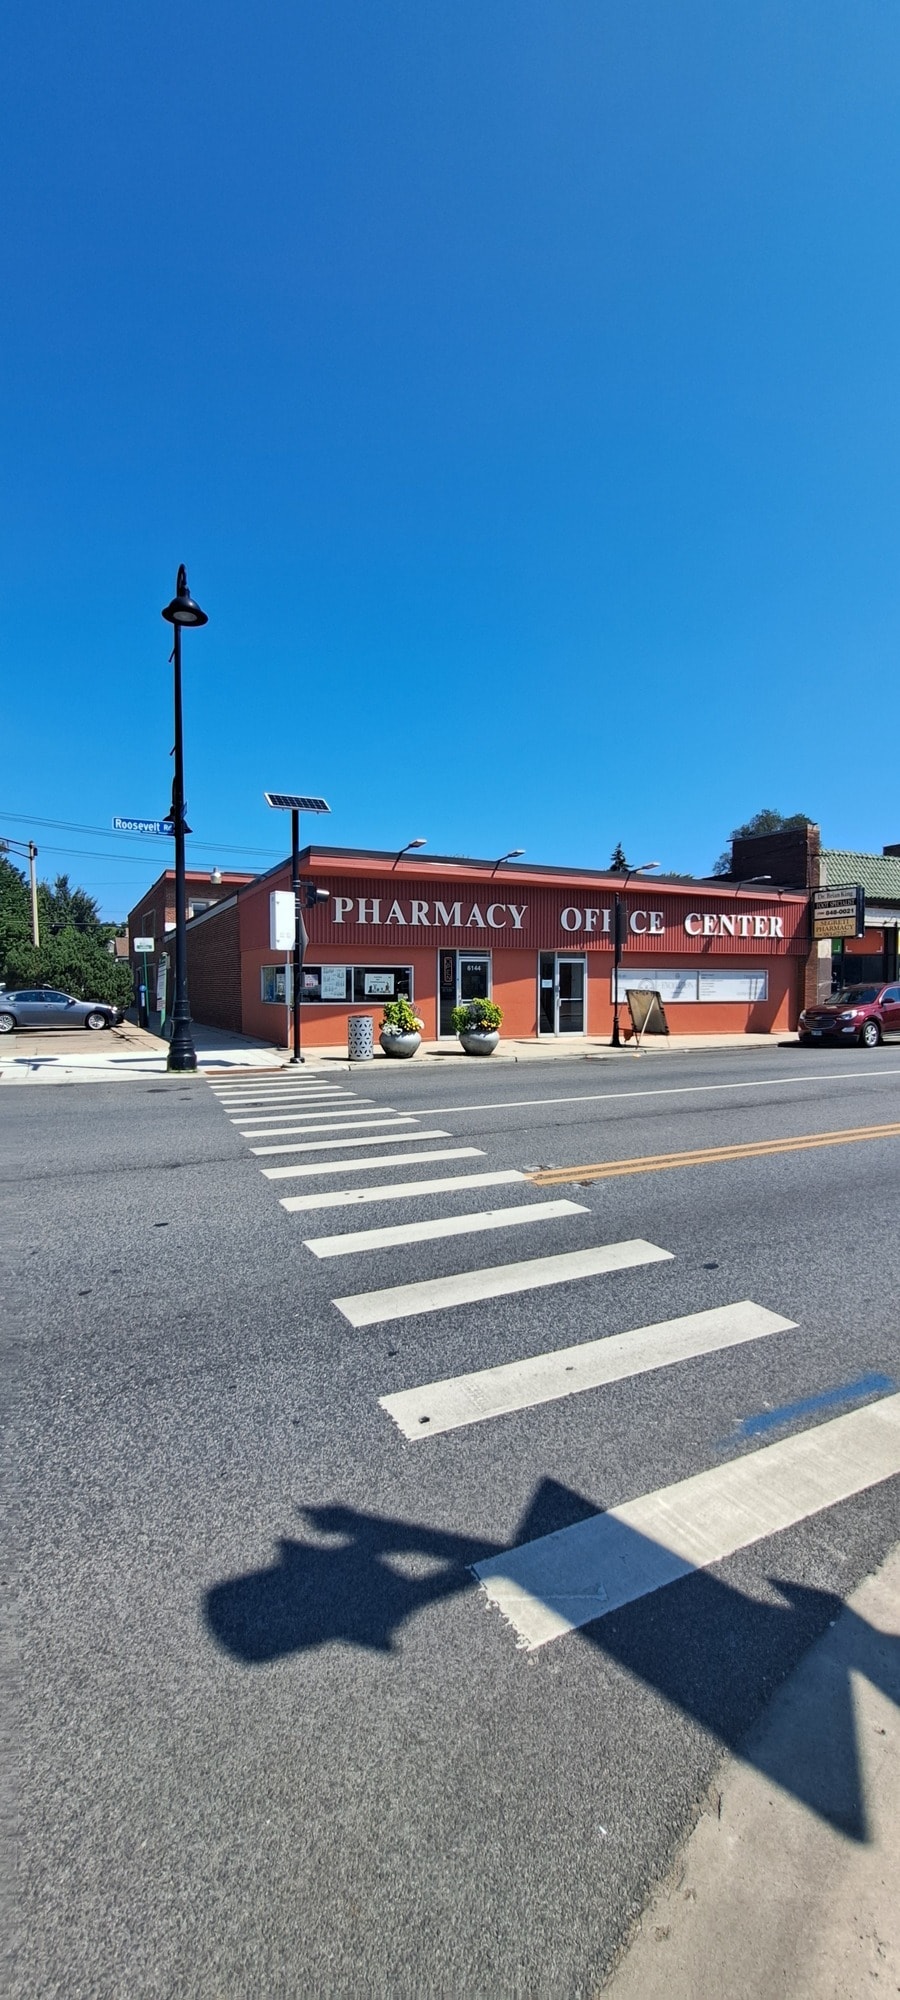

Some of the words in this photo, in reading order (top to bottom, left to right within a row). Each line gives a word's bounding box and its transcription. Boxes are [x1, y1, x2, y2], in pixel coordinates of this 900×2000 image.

[116, 818, 160, 831] Roosevelt
[332, 897, 528, 929] PHARMACY
[560, 907, 664, 934] OFFCE
[684, 912, 784, 938] CENTER
